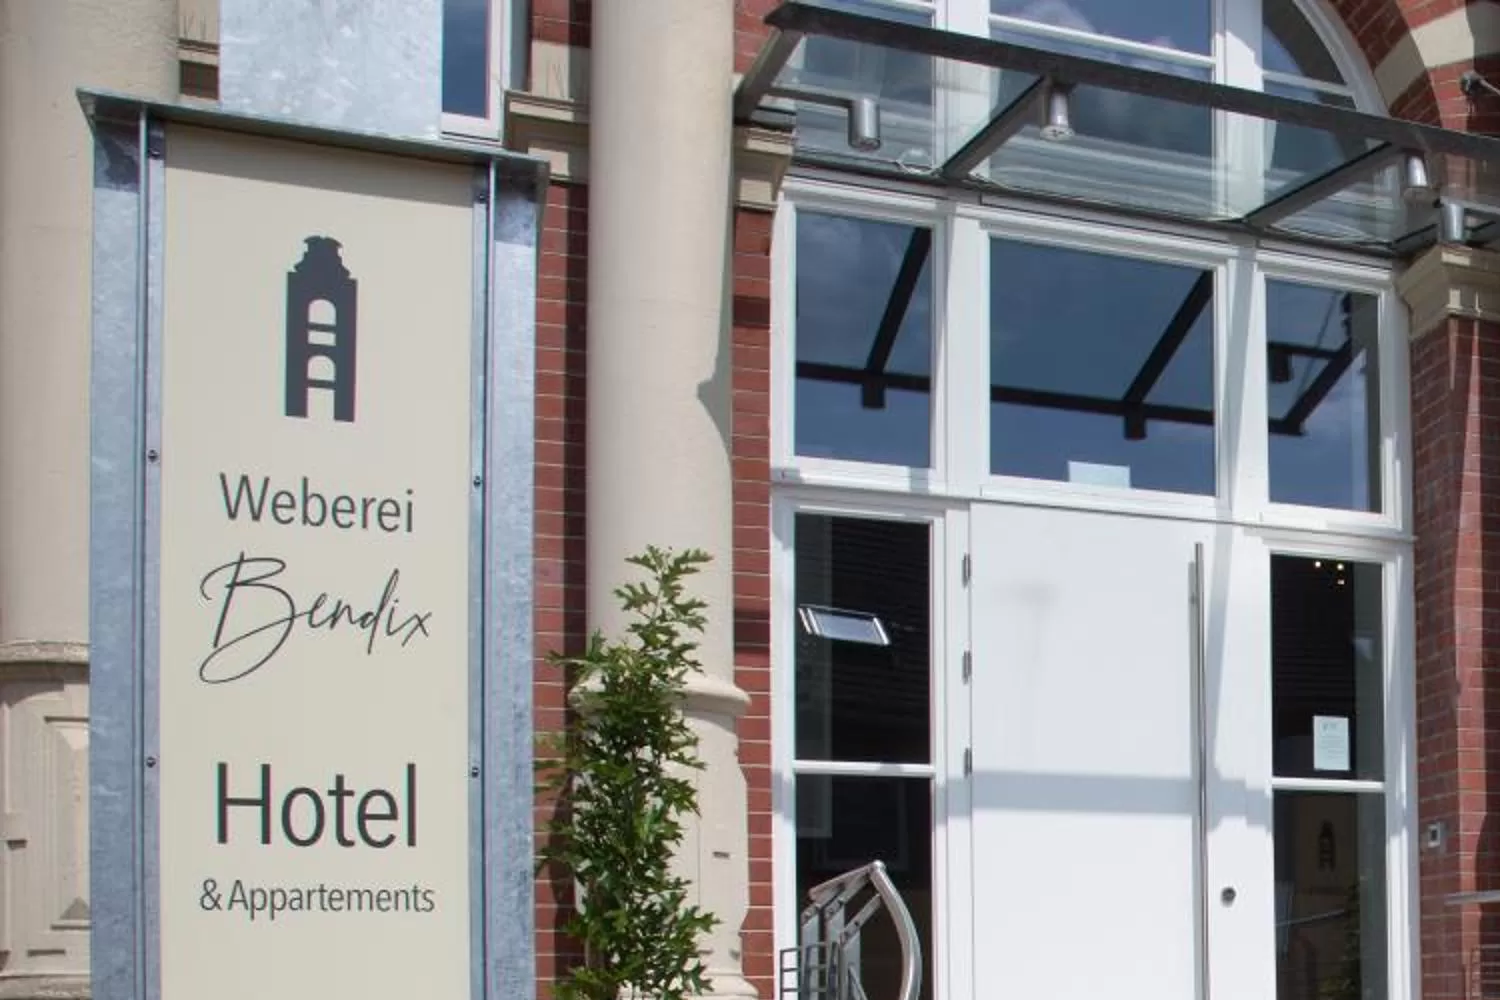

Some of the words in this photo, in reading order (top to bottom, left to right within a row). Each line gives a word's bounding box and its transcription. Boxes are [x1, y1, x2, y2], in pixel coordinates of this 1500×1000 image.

[219, 472, 414, 533] Weberei
[199, 551, 433, 684] Bendix
[216, 762, 417, 848] Hotel
[199, 878, 222, 911] &
[228, 879, 436, 921] Appartements
